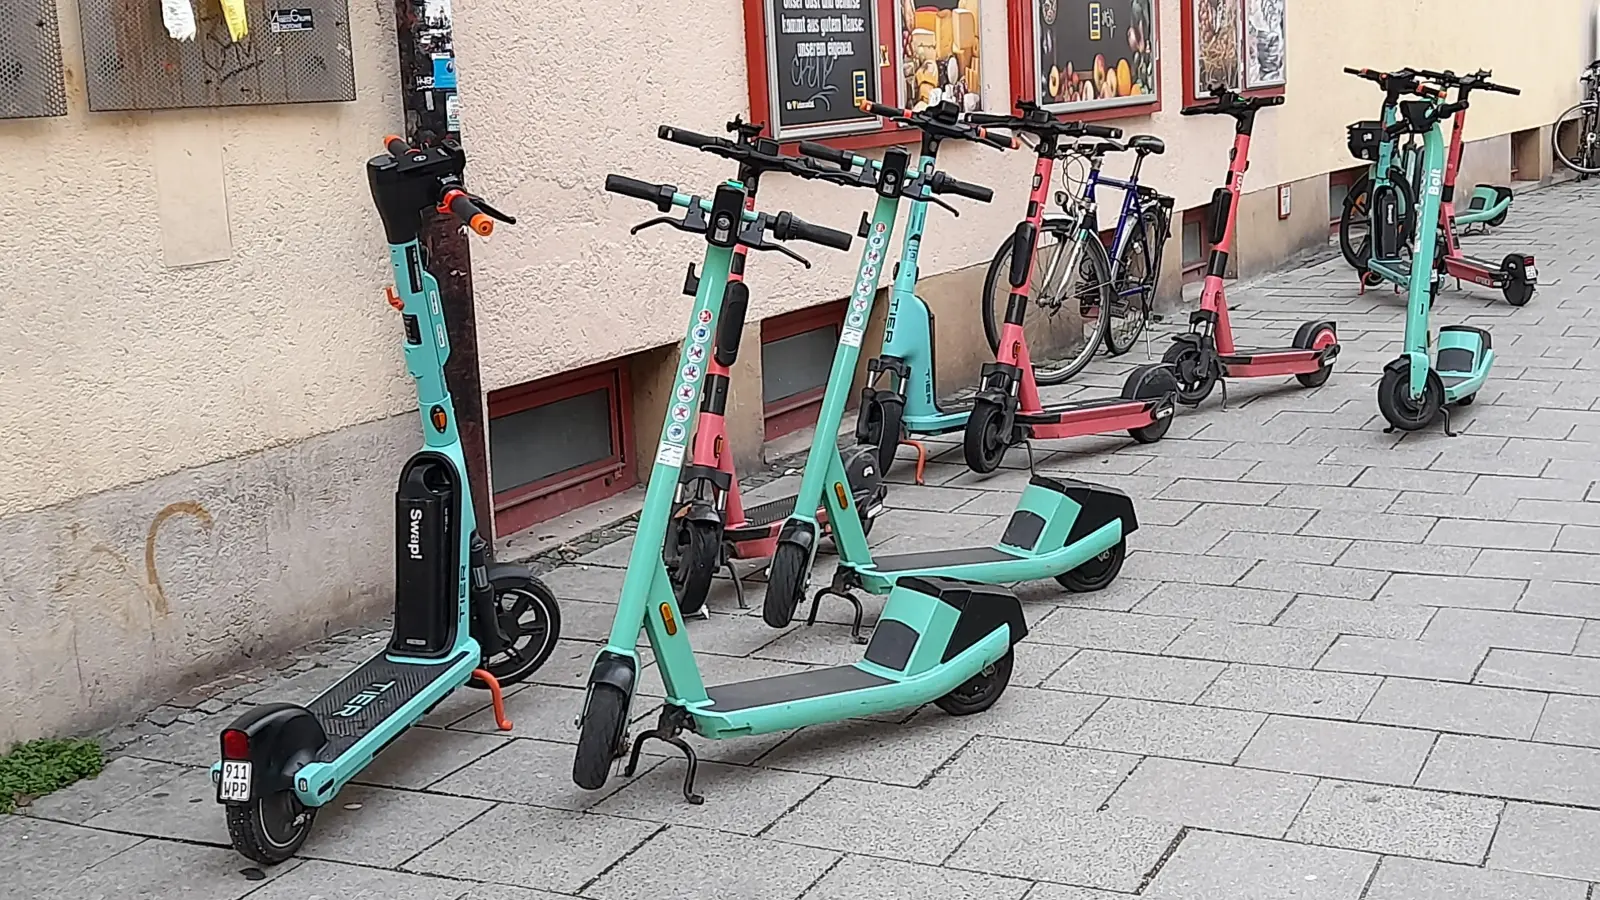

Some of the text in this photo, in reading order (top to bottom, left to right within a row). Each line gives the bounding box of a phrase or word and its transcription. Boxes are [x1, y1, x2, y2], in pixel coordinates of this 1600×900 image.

[781, 14, 806, 33] kommt
[807, 18, 819, 33] aus
[820, 16, 841, 37] gutem
[797, 42, 826, 57] unserem
[1428, 168, 1441, 196] Bolt
[884, 298, 900, 344] TIER
[408, 509, 422, 560] Swap!
[459, 564, 467, 623] TIER
[333, 680, 396, 718] TIER
[225, 764, 247, 780] 911
[223, 781, 247, 799] WPP
